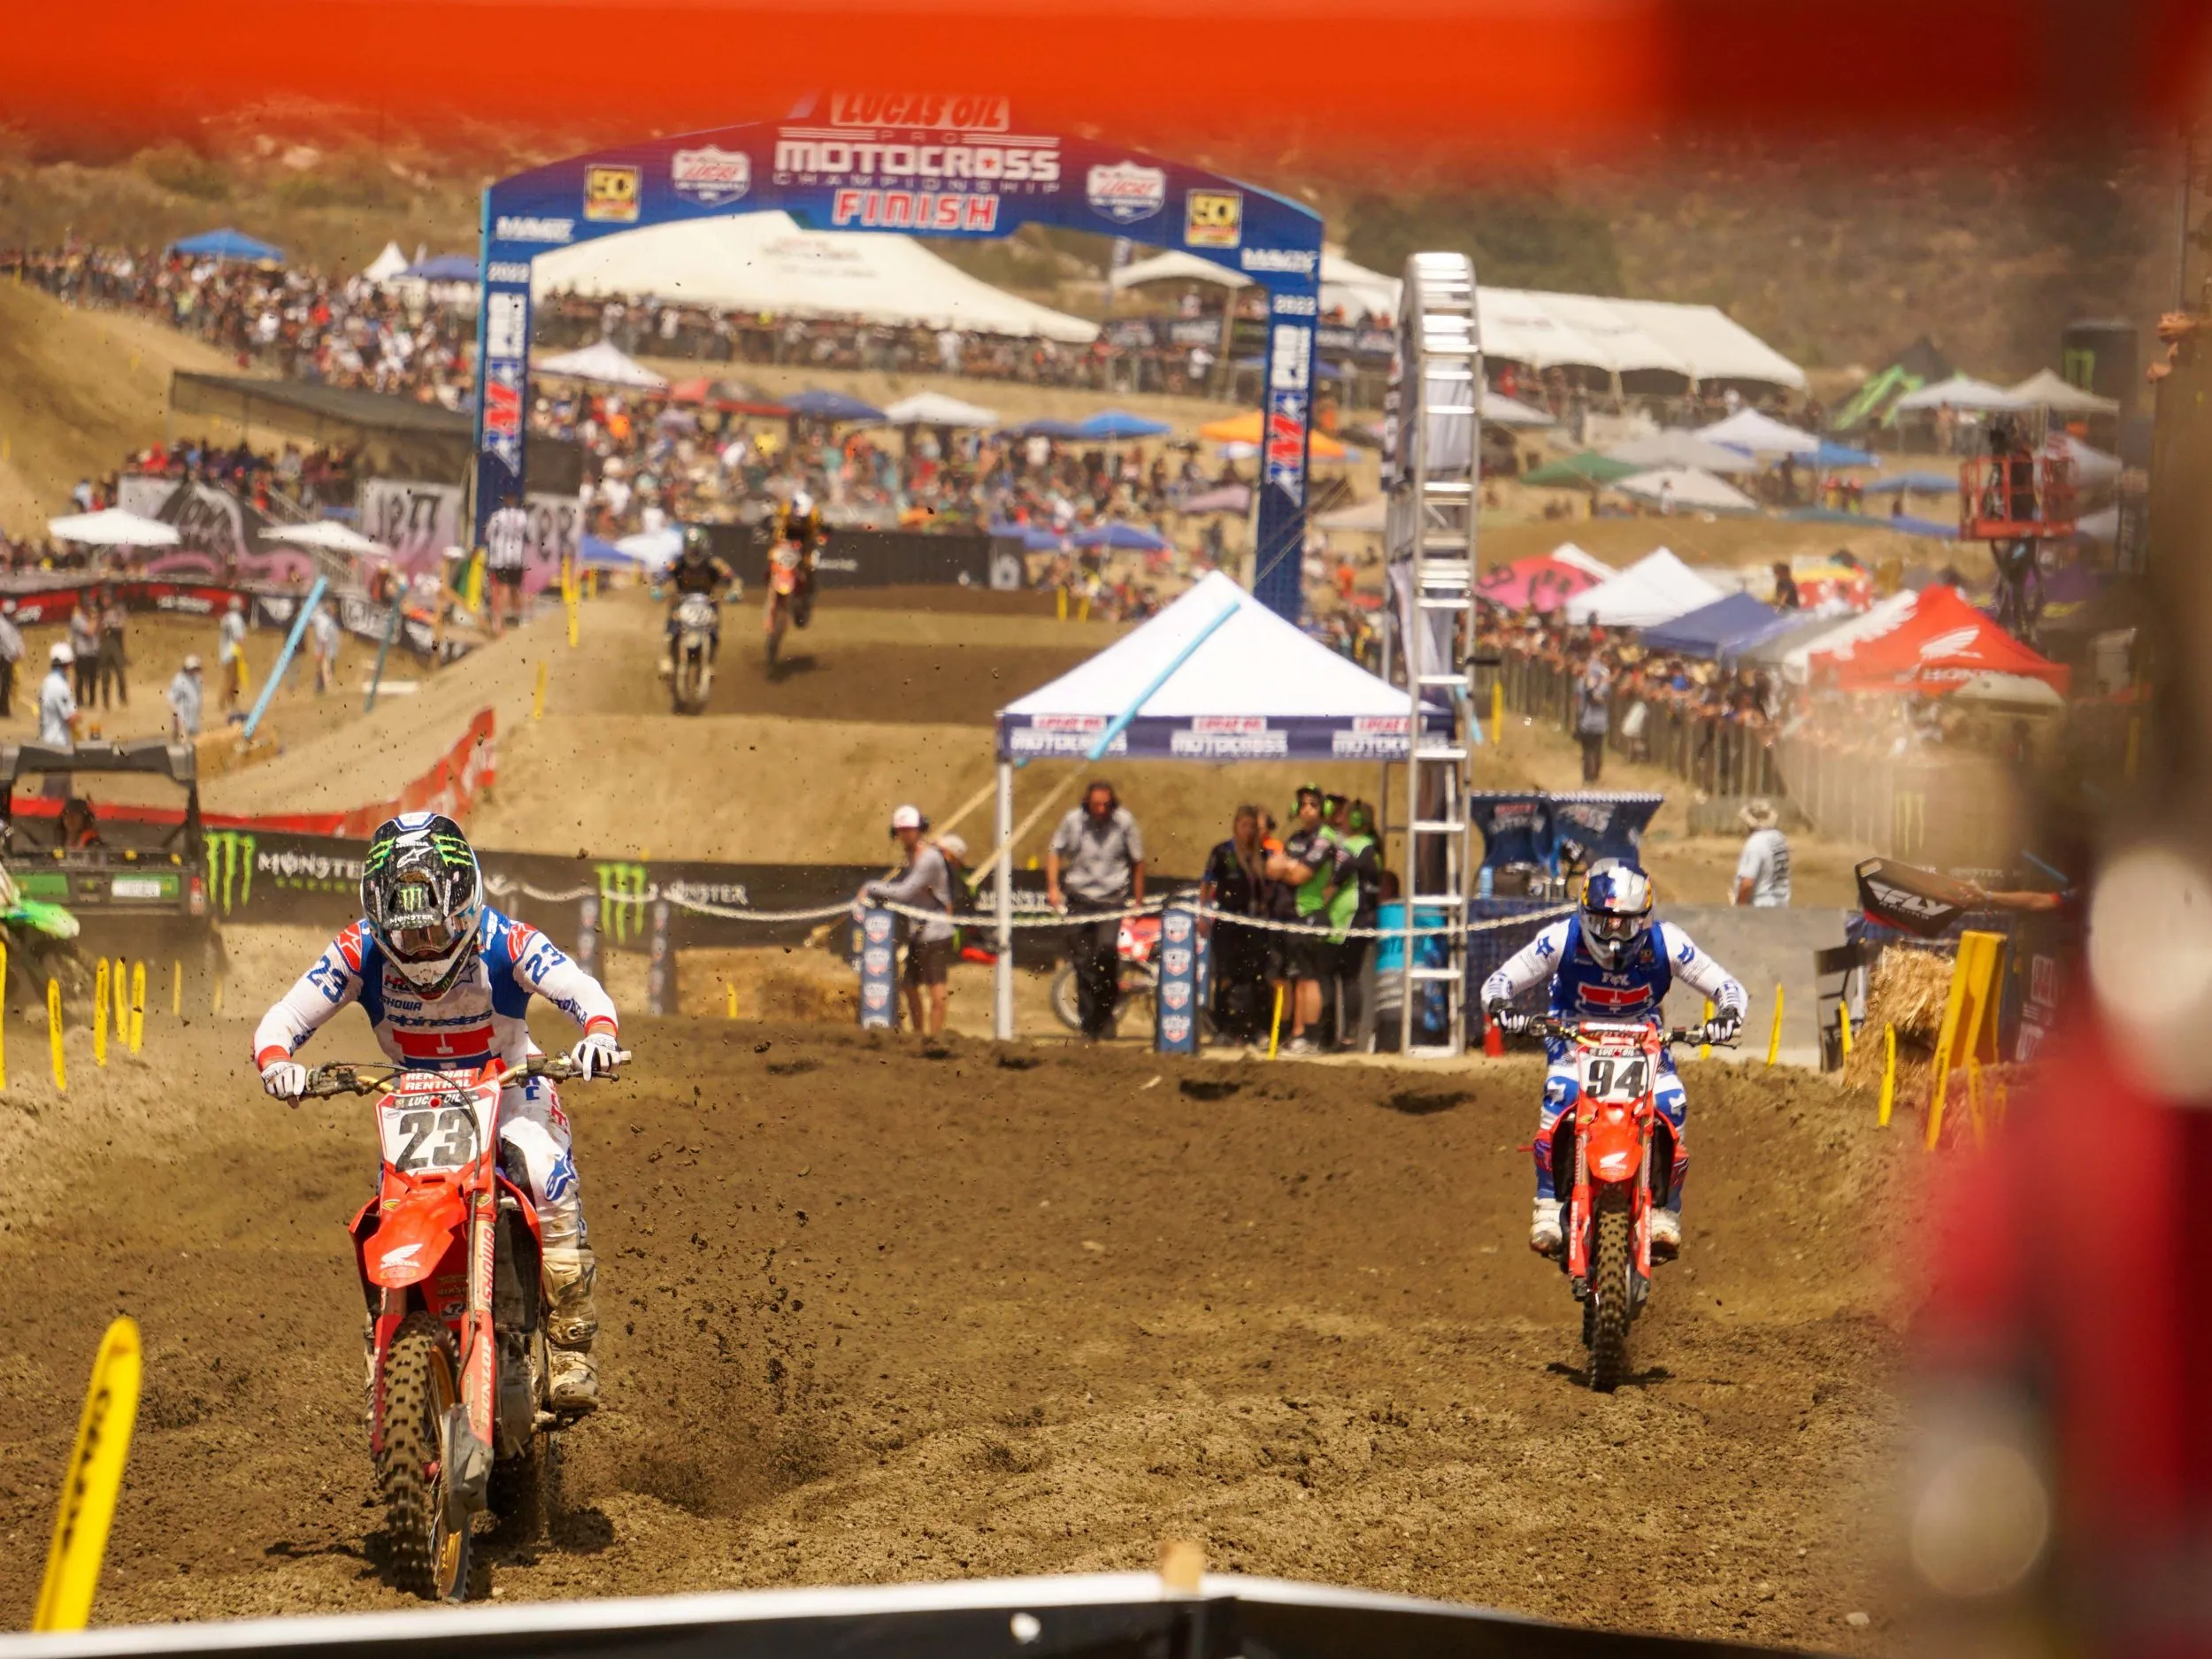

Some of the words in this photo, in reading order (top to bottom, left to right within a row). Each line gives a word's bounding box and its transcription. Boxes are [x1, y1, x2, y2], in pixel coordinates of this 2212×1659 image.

[839, 93, 943, 127] LUCAS
[949, 96, 1004, 128] OIL
[880, 130, 959, 144] PRO
[774, 142, 1060, 180] MOTOCROSS
[772, 172, 1060, 194] CHAMPIONSHIP
[832, 188, 999, 231] FINISH
[257, 851, 365, 880] MONSTE
[1874, 883, 1954, 917] FLY
[389, 914, 434, 924] MONSTER
[306, 955, 349, 1003] 23
[525, 943, 567, 986] 23
[384, 974, 410, 991] HR
[388, 1010, 494, 1027] alpinestars
[1586, 1059, 1646, 1098] 94
[443, 1094, 462, 1104] OIL
[396, 1108, 475, 1173] 23
[482, 1226, 495, 1304] SHOWA
[480, 1334, 493, 1430] DUNLOP
